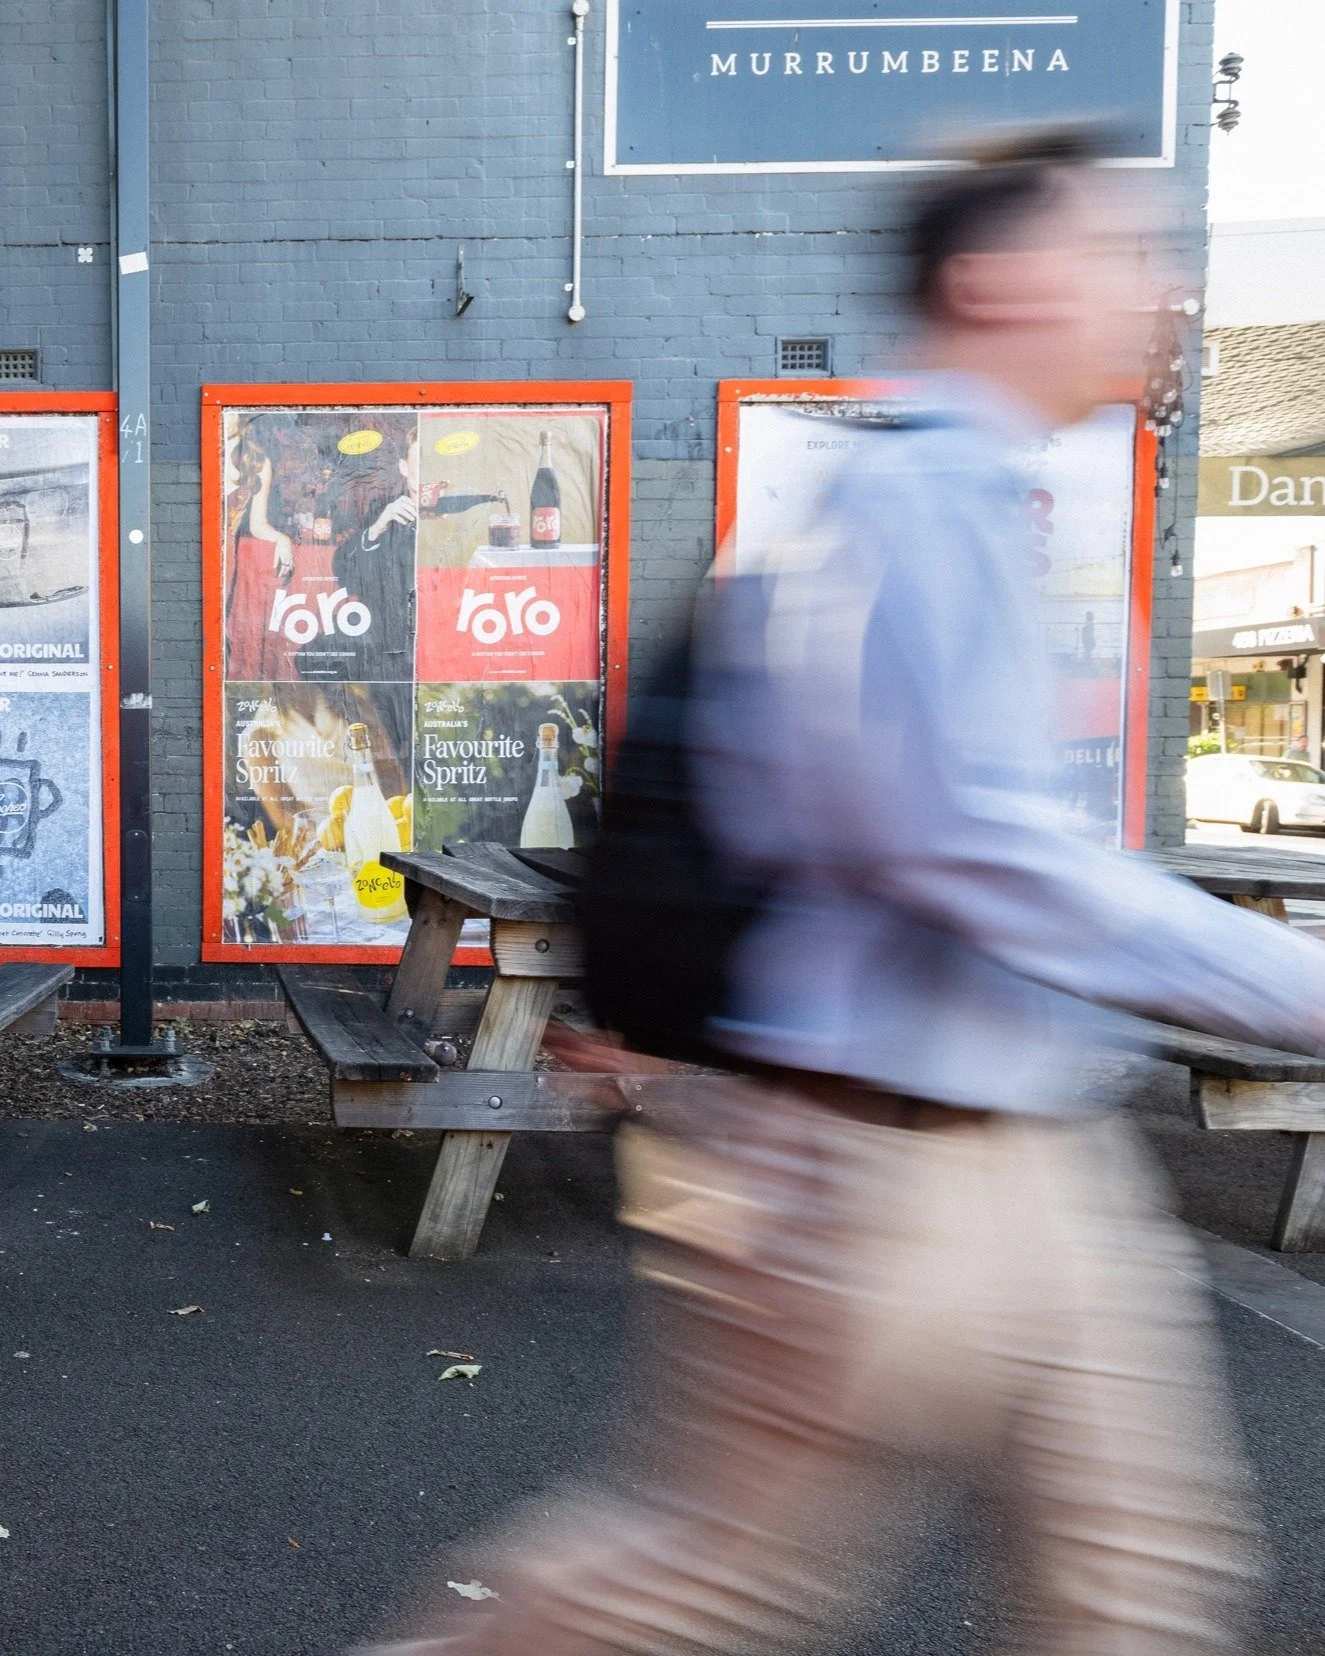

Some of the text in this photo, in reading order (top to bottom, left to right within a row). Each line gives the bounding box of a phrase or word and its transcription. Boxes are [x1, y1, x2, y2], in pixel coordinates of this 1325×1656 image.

[710, 49, 1070, 76] MURRUMBEENA
[120, 413, 147, 438] 4A
[807, 441, 850, 450] EXPLORE
[268, 587, 372, 645] roro
[456, 586, 561, 645] roro
[0, 643, 84, 659] ORIGINAL
[423, 720, 469, 728] AUSTRALIA'S
[235, 733, 335, 758] Favourite
[423, 733, 525, 758] Favourite
[235, 758, 298, 789] Spritz
[423, 759, 488, 790] Spritz
[0, 903, 84, 918] ORIGINAL
